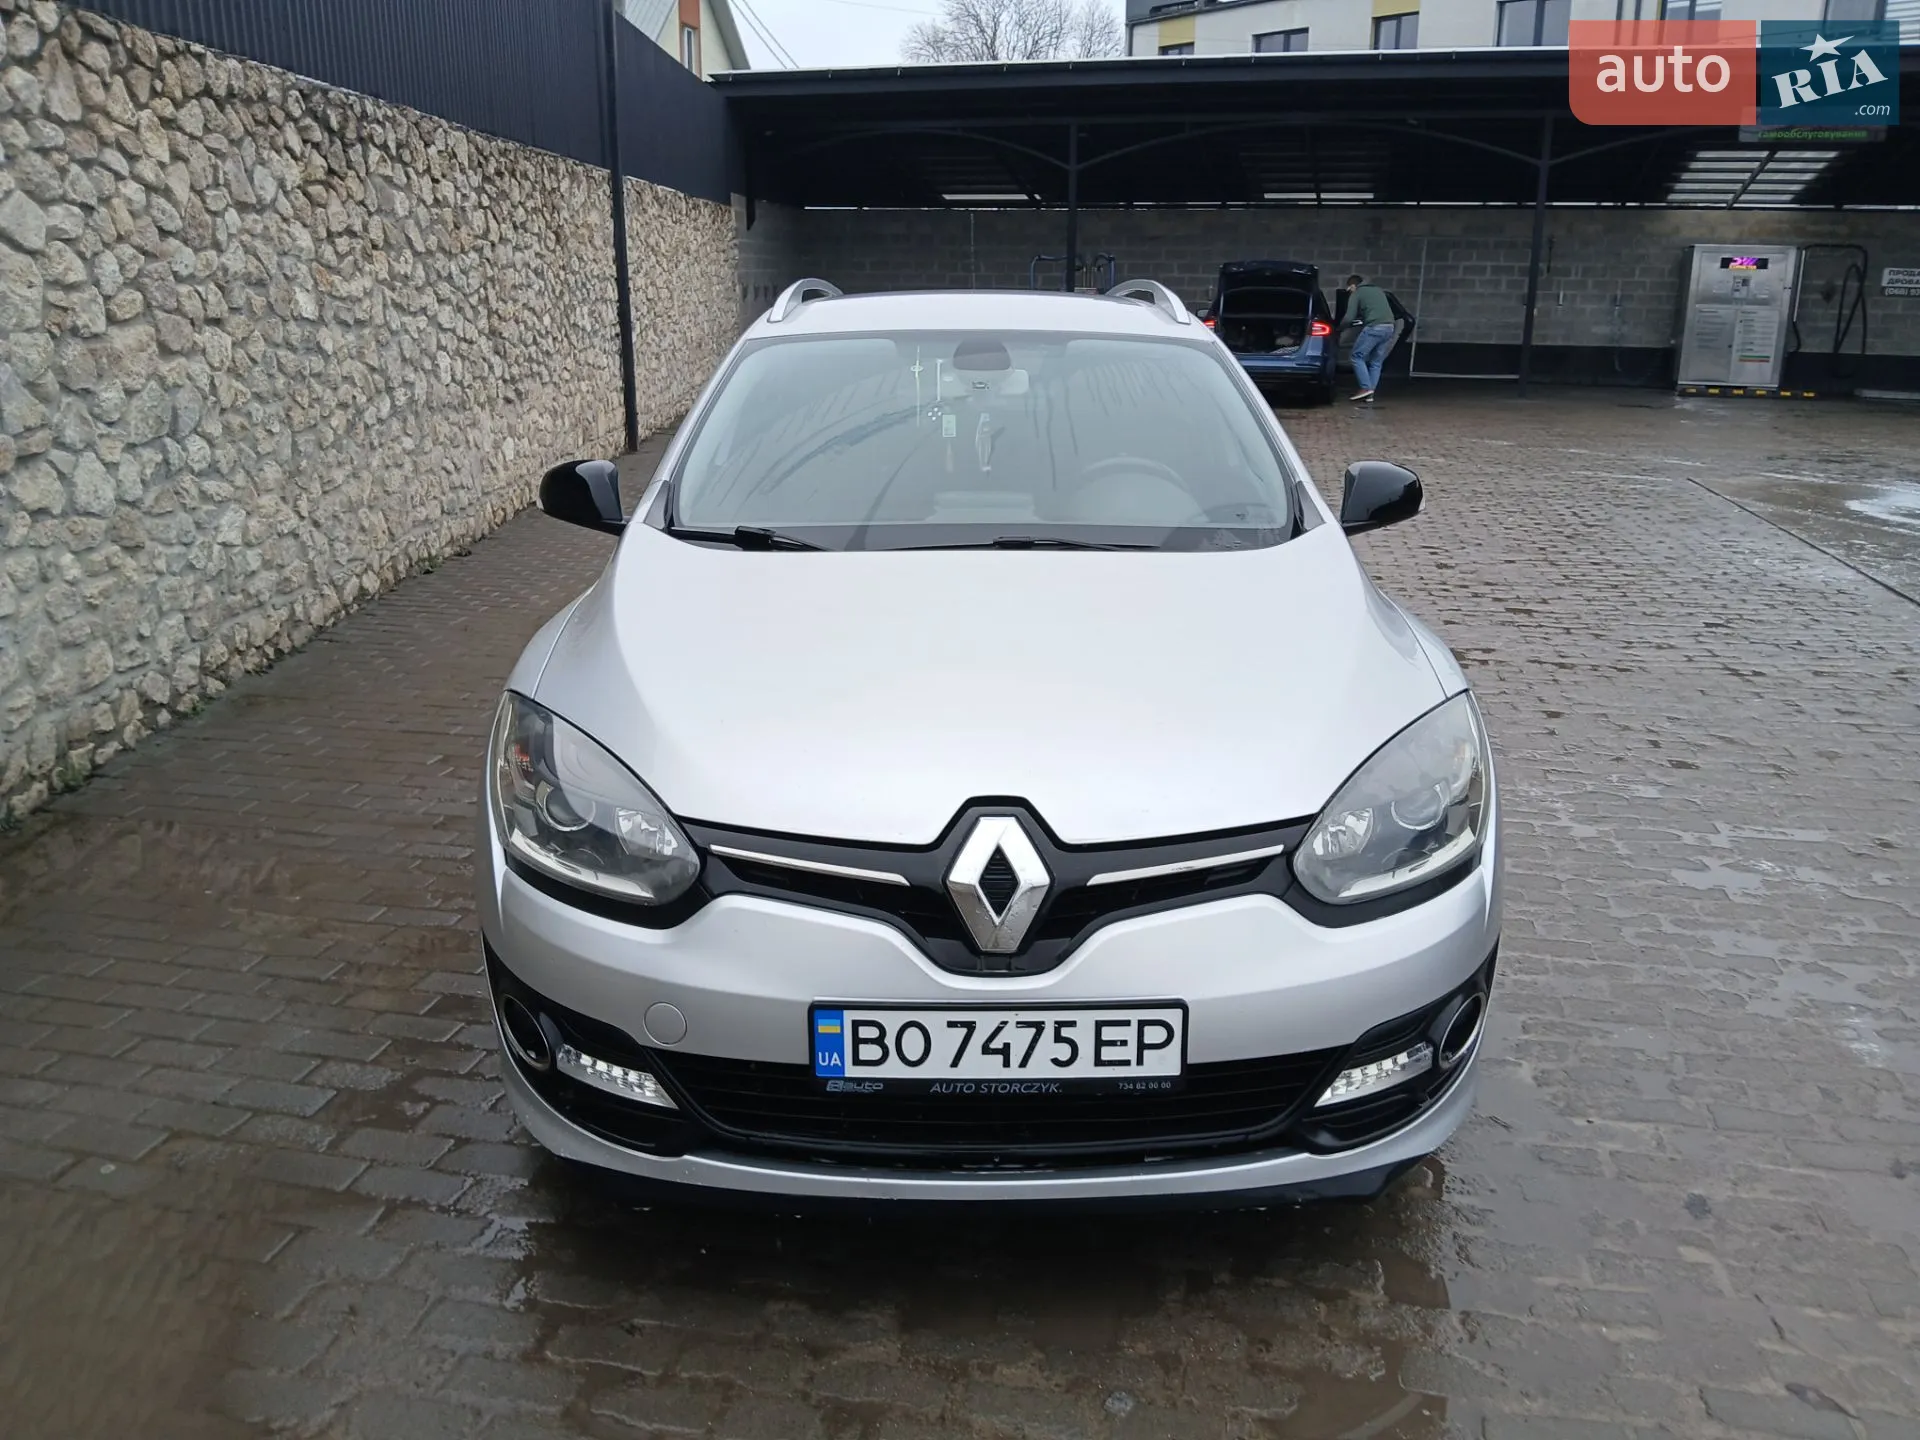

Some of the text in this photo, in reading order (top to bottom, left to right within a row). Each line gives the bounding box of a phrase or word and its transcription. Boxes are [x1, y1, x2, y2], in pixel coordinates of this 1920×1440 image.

[850, 1019, 1175, 1069] BO 7475 EP
[818, 1052, 842, 1067] UA
[930, 1082, 975, 1094] AUTO
